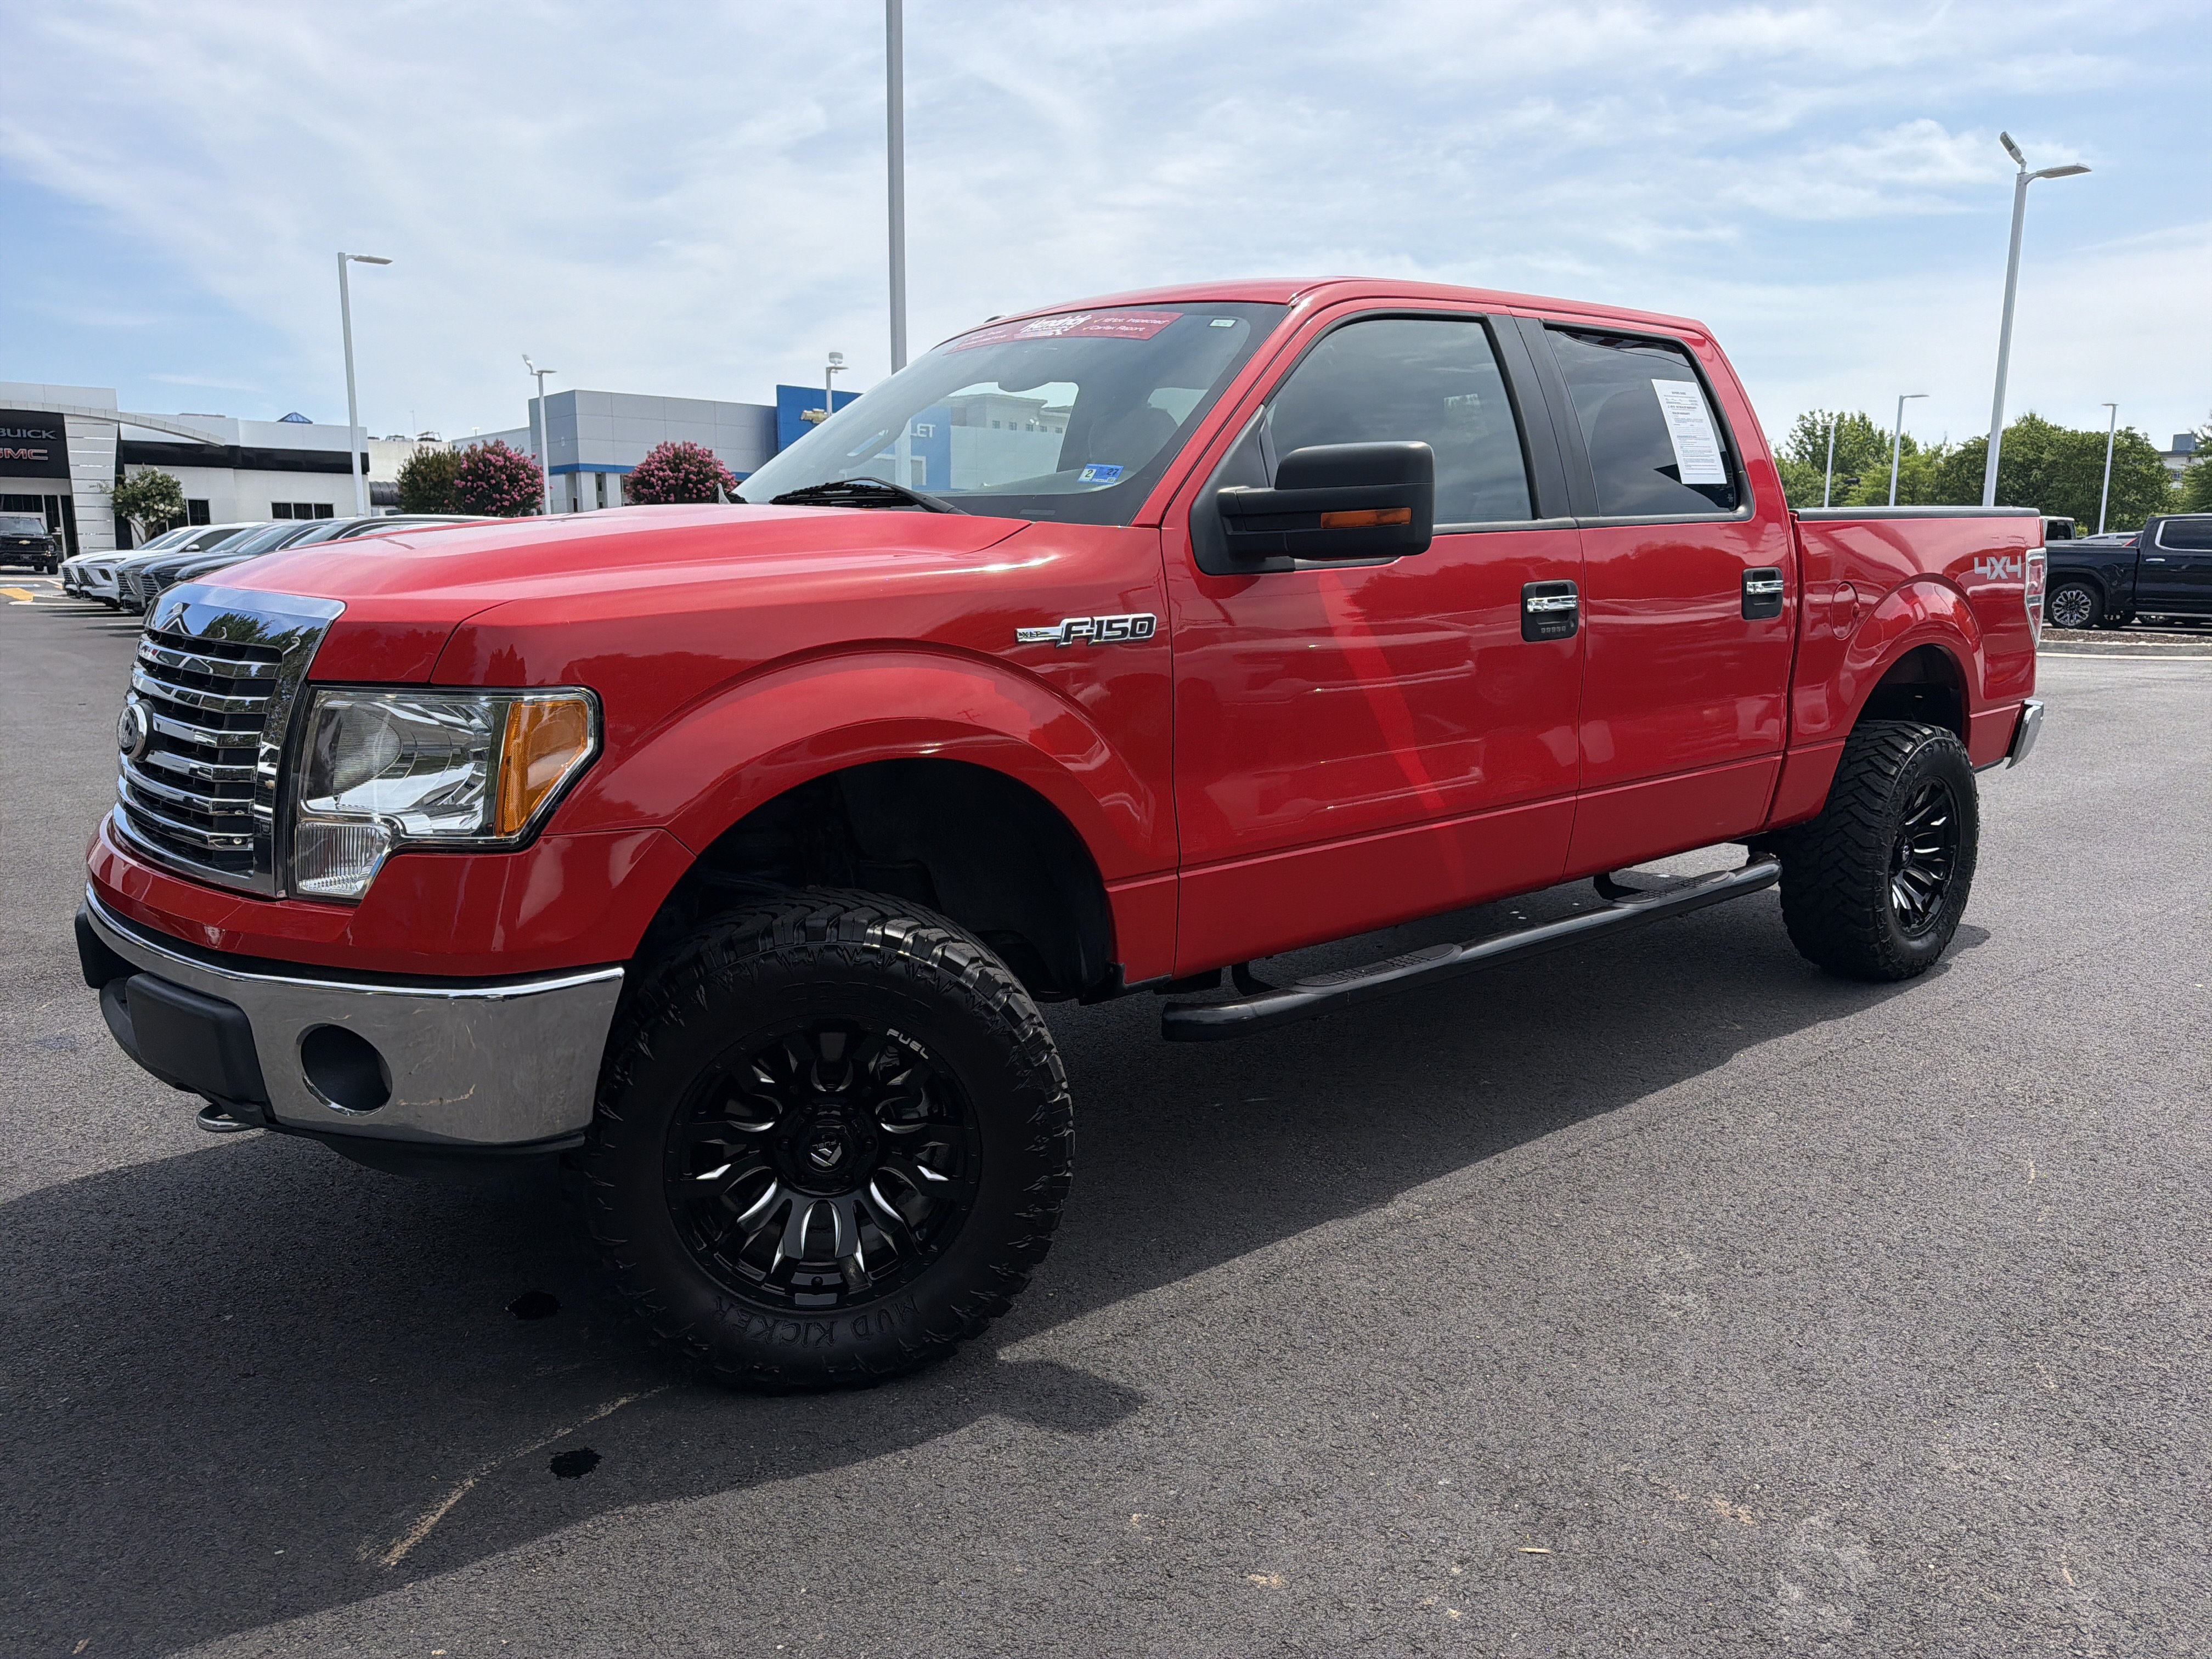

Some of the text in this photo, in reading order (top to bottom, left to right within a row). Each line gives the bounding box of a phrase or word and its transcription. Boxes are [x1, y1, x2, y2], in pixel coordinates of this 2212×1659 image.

[1020, 315, 1092, 334] Hendrick
[0, 448, 48, 460] MC
[1085, 469, 1094, 478] 2
[1106, 468, 1120, 477] 27
[886, 1028, 929, 1059] FUEL
[812, 1139, 837, 1149] FUEL
[851, 1294, 921, 1341] MUD
